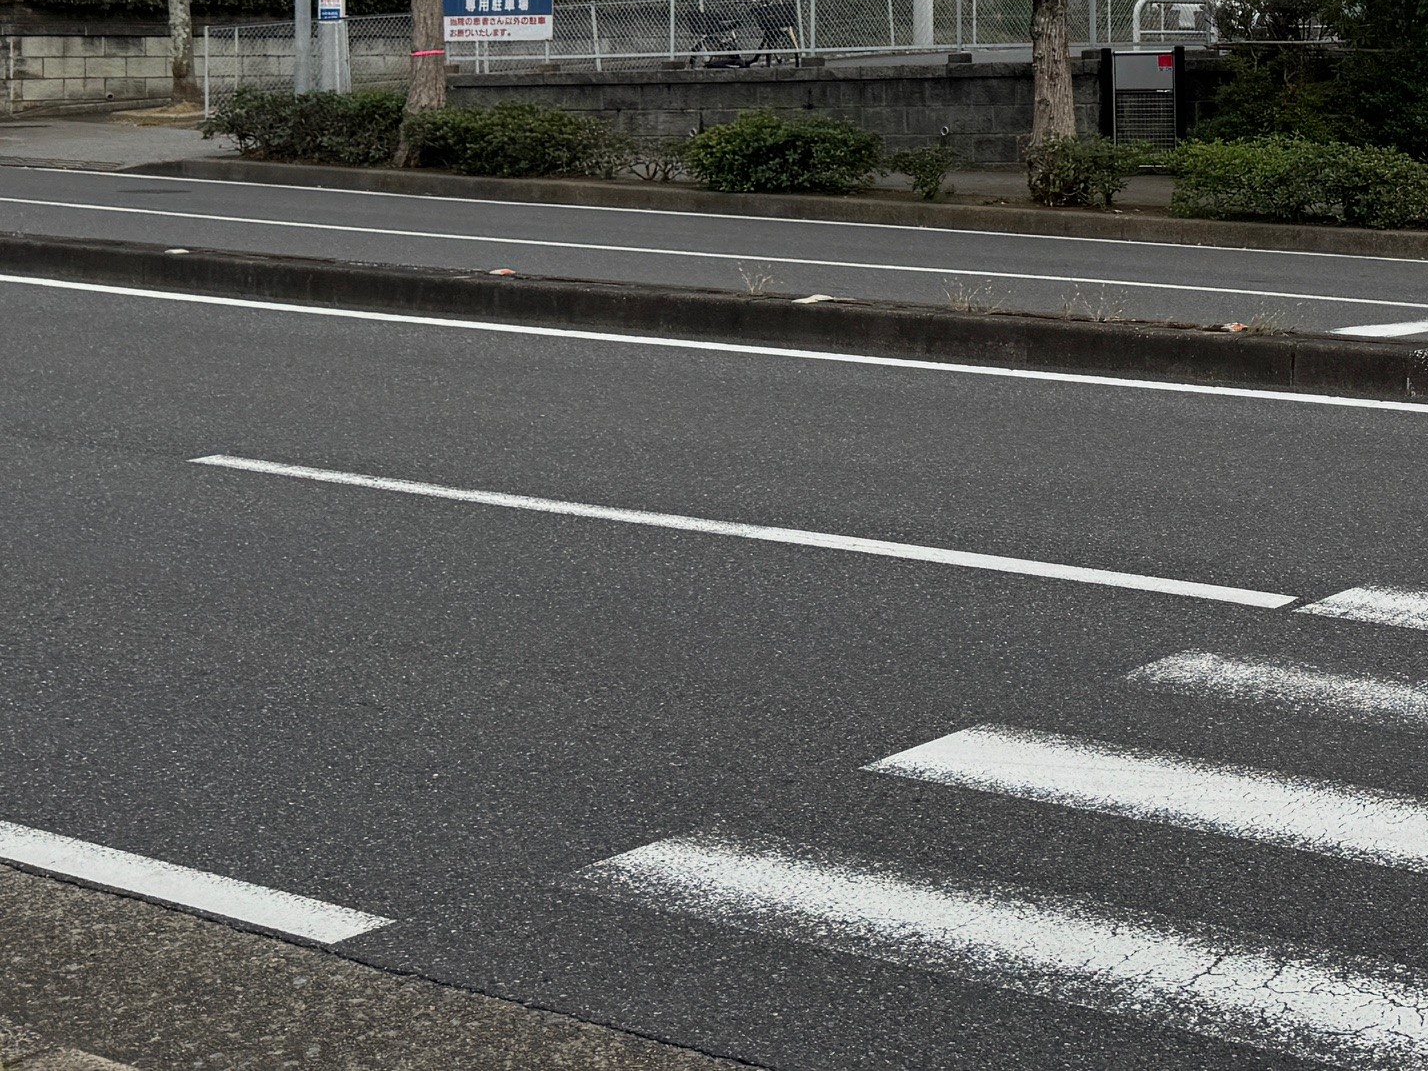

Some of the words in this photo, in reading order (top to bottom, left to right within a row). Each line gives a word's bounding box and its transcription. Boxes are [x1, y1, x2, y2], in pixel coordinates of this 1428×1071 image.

[450, 16, 546, 27] 当院の患者さん以外の駐車
[450, 28, 512, 38] お断りいたします。
